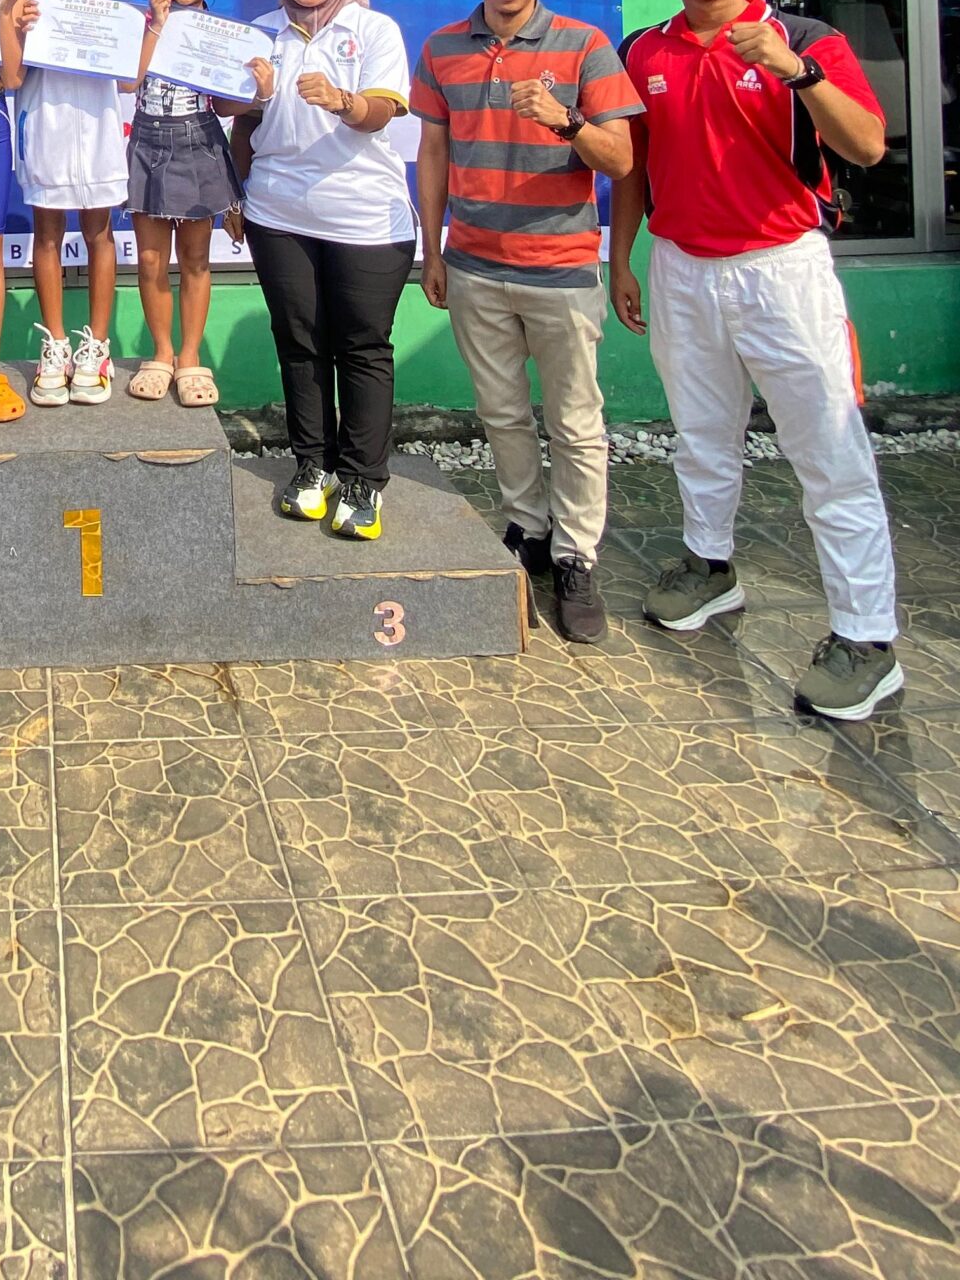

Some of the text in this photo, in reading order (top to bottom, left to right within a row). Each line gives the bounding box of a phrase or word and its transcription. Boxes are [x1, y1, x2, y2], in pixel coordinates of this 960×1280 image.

[64, 3, 110, 15] SERTIFIKAT
[735, 80, 762, 90] AREA
[62, 508, 104, 598] 1
[373, 601, 407, 646] 3
